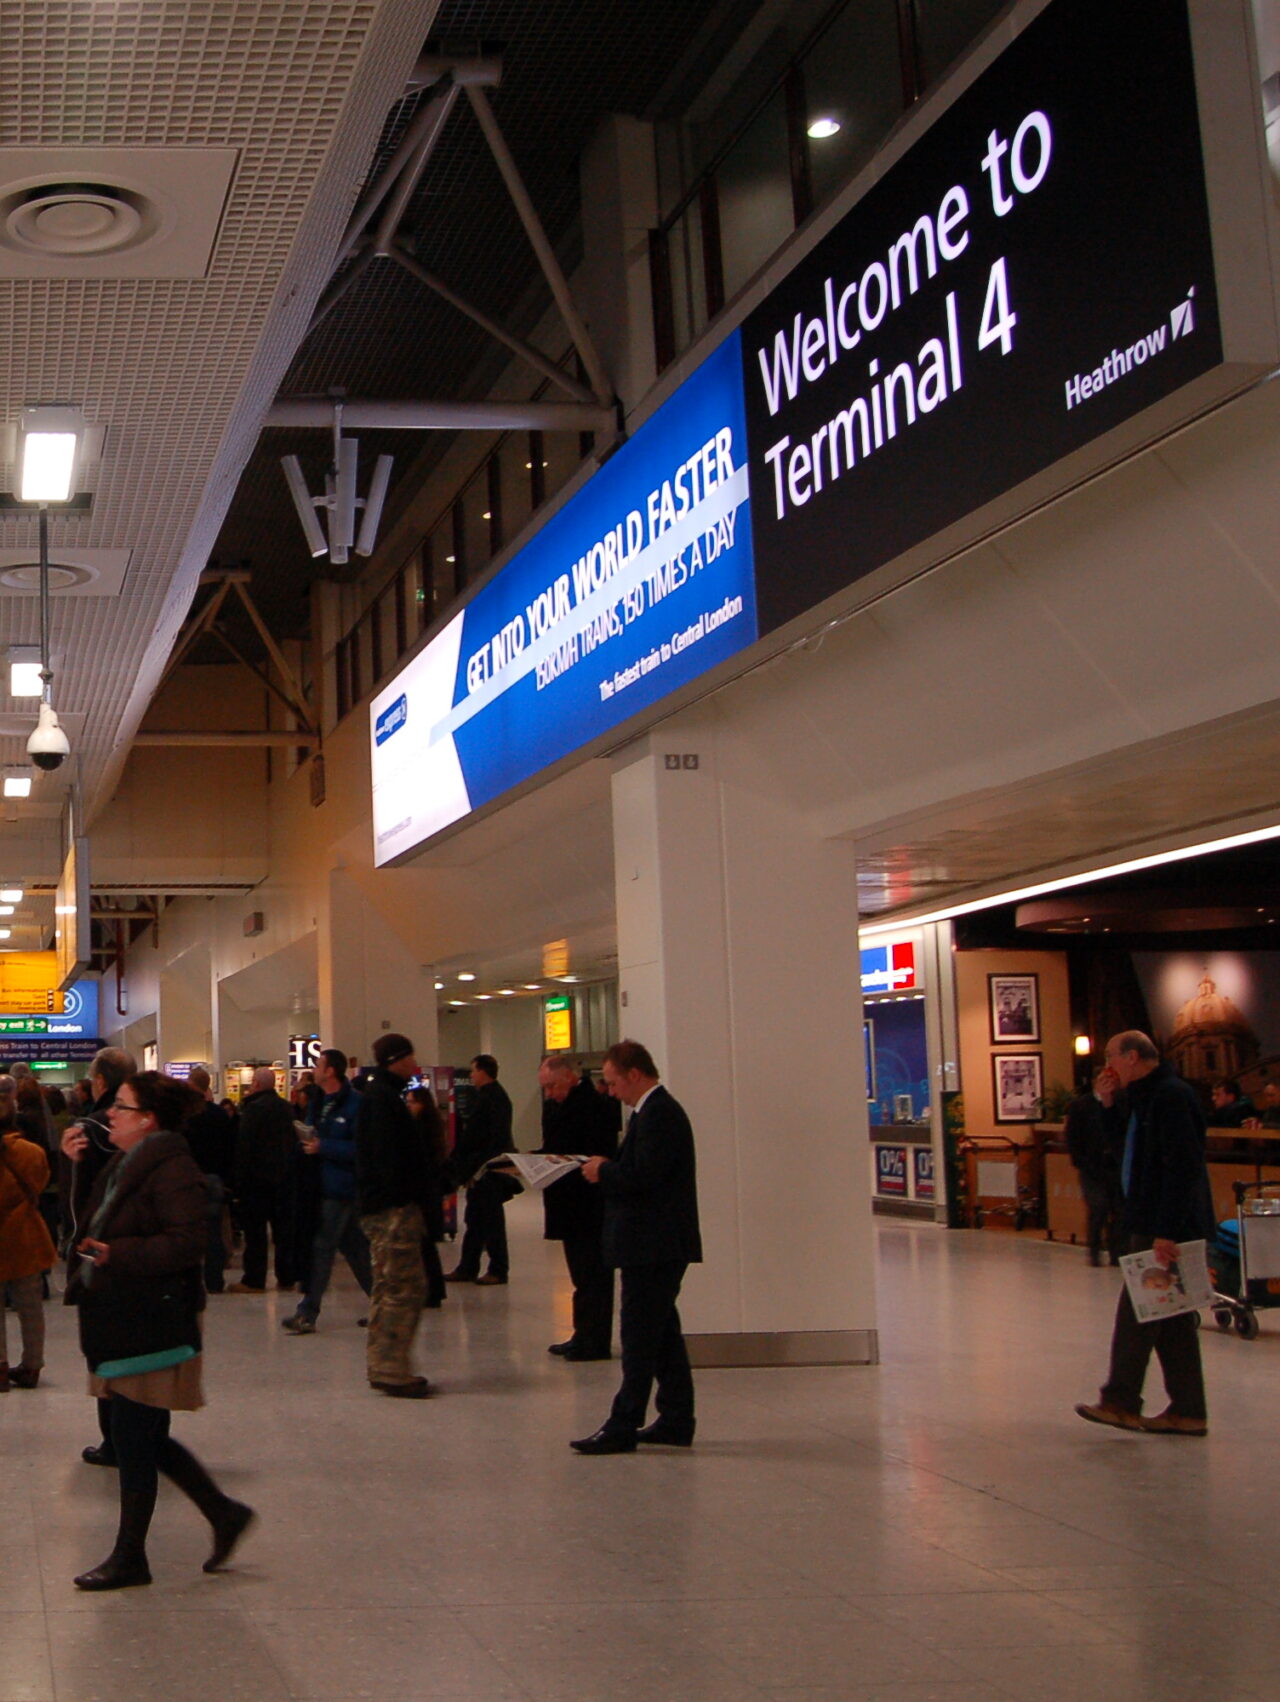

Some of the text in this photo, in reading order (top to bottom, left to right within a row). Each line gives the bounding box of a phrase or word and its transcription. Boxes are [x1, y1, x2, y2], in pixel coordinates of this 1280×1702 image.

[757, 110, 1052, 416] Welcome to
[763, 256, 1018, 520] Terminal 4
[1064, 323, 1168, 411] Heathrow
[466, 426, 735, 696] GET INTO YOUR WORLD FASTER
[579, 599, 624, 658] TRAINS,
[622, 579, 645, 626] 150
[644, 548, 688, 607] TIMES
[690, 535, 704, 578] A
[705, 506, 738, 565] DAY
[599, 595, 743, 701] The fastest train to Central London
[8, 1021, 25, 1029] exit
[11, 1041, 29, 1049] Train
[30, 1041, 39, 1049] to
[40, 1041, 67, 1049] Central
[69, 1041, 97, 1049] London
[47, 1024, 83, 1034] London
